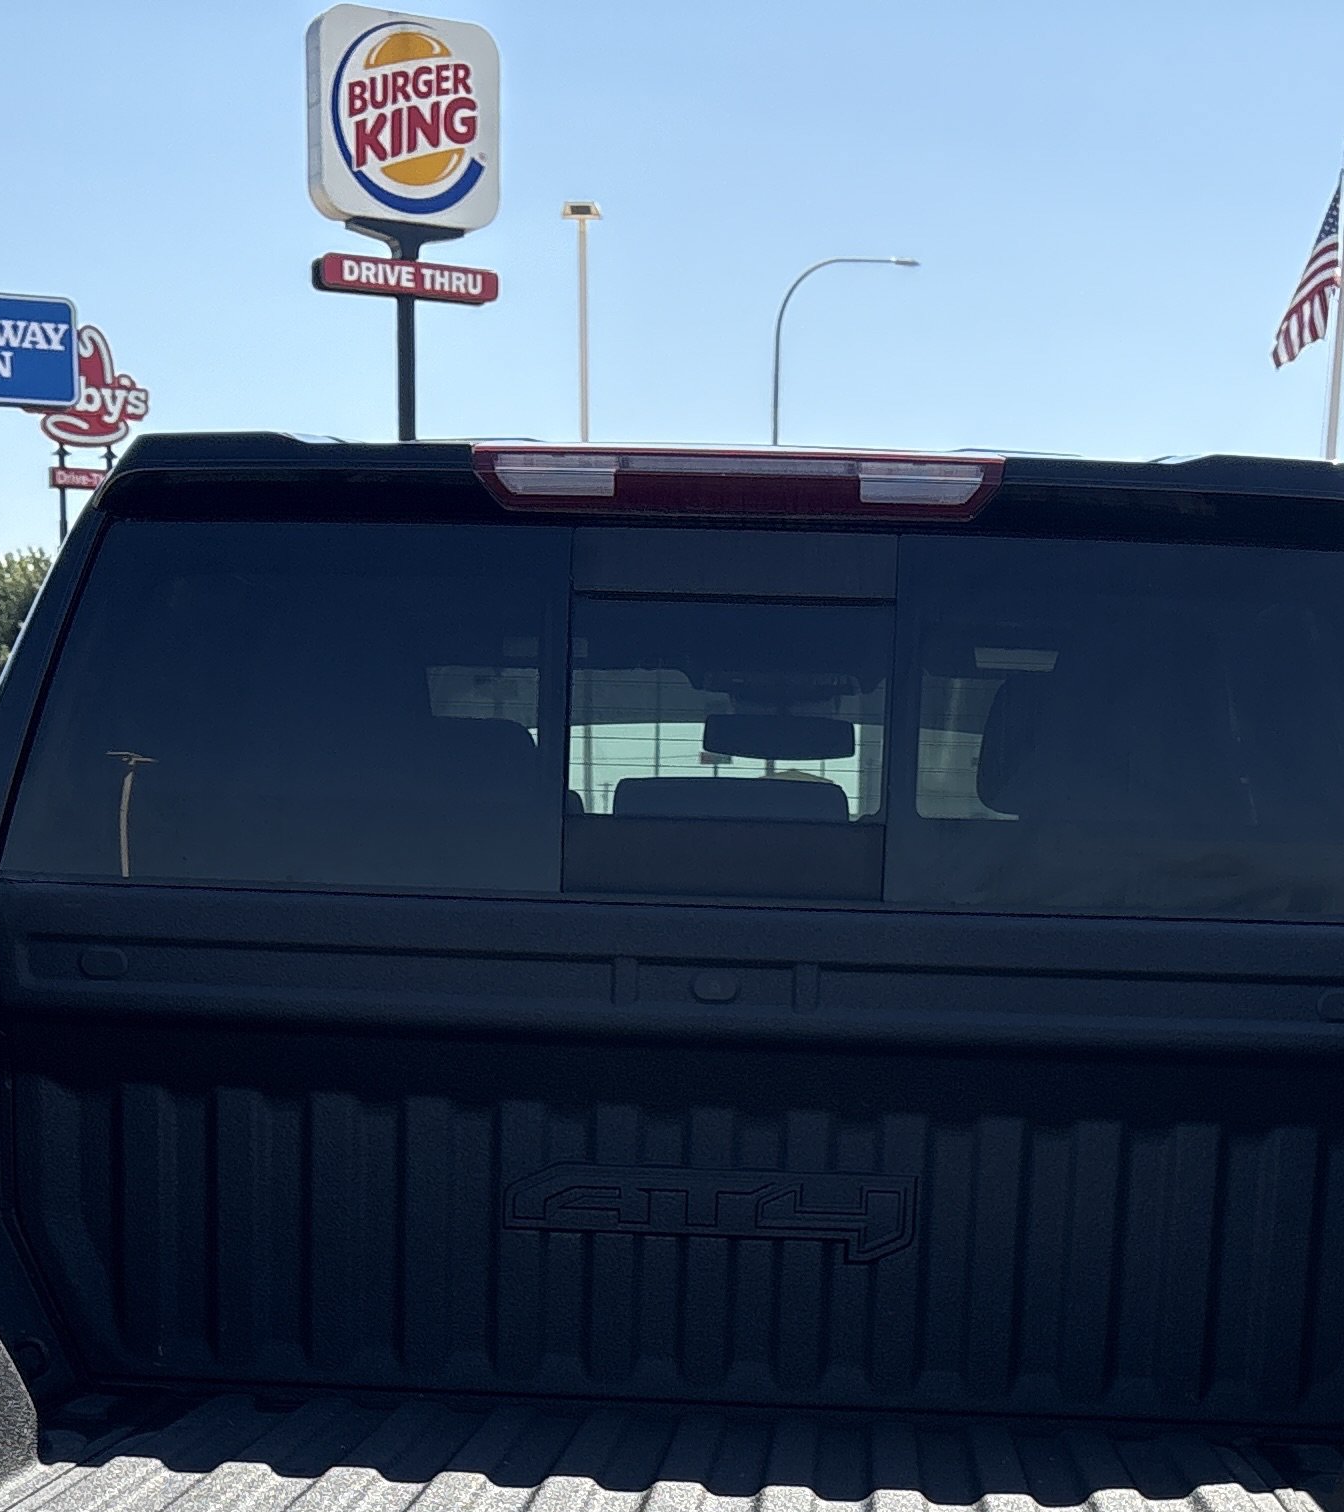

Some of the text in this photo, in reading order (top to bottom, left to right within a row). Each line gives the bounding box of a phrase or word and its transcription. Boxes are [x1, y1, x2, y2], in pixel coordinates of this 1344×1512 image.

[348, 63, 473, 118] BURGER
[354, 97, 478, 168] KING
[341, 259, 483, 295] DRIVE THRU
[75, 375, 147, 424] by's
